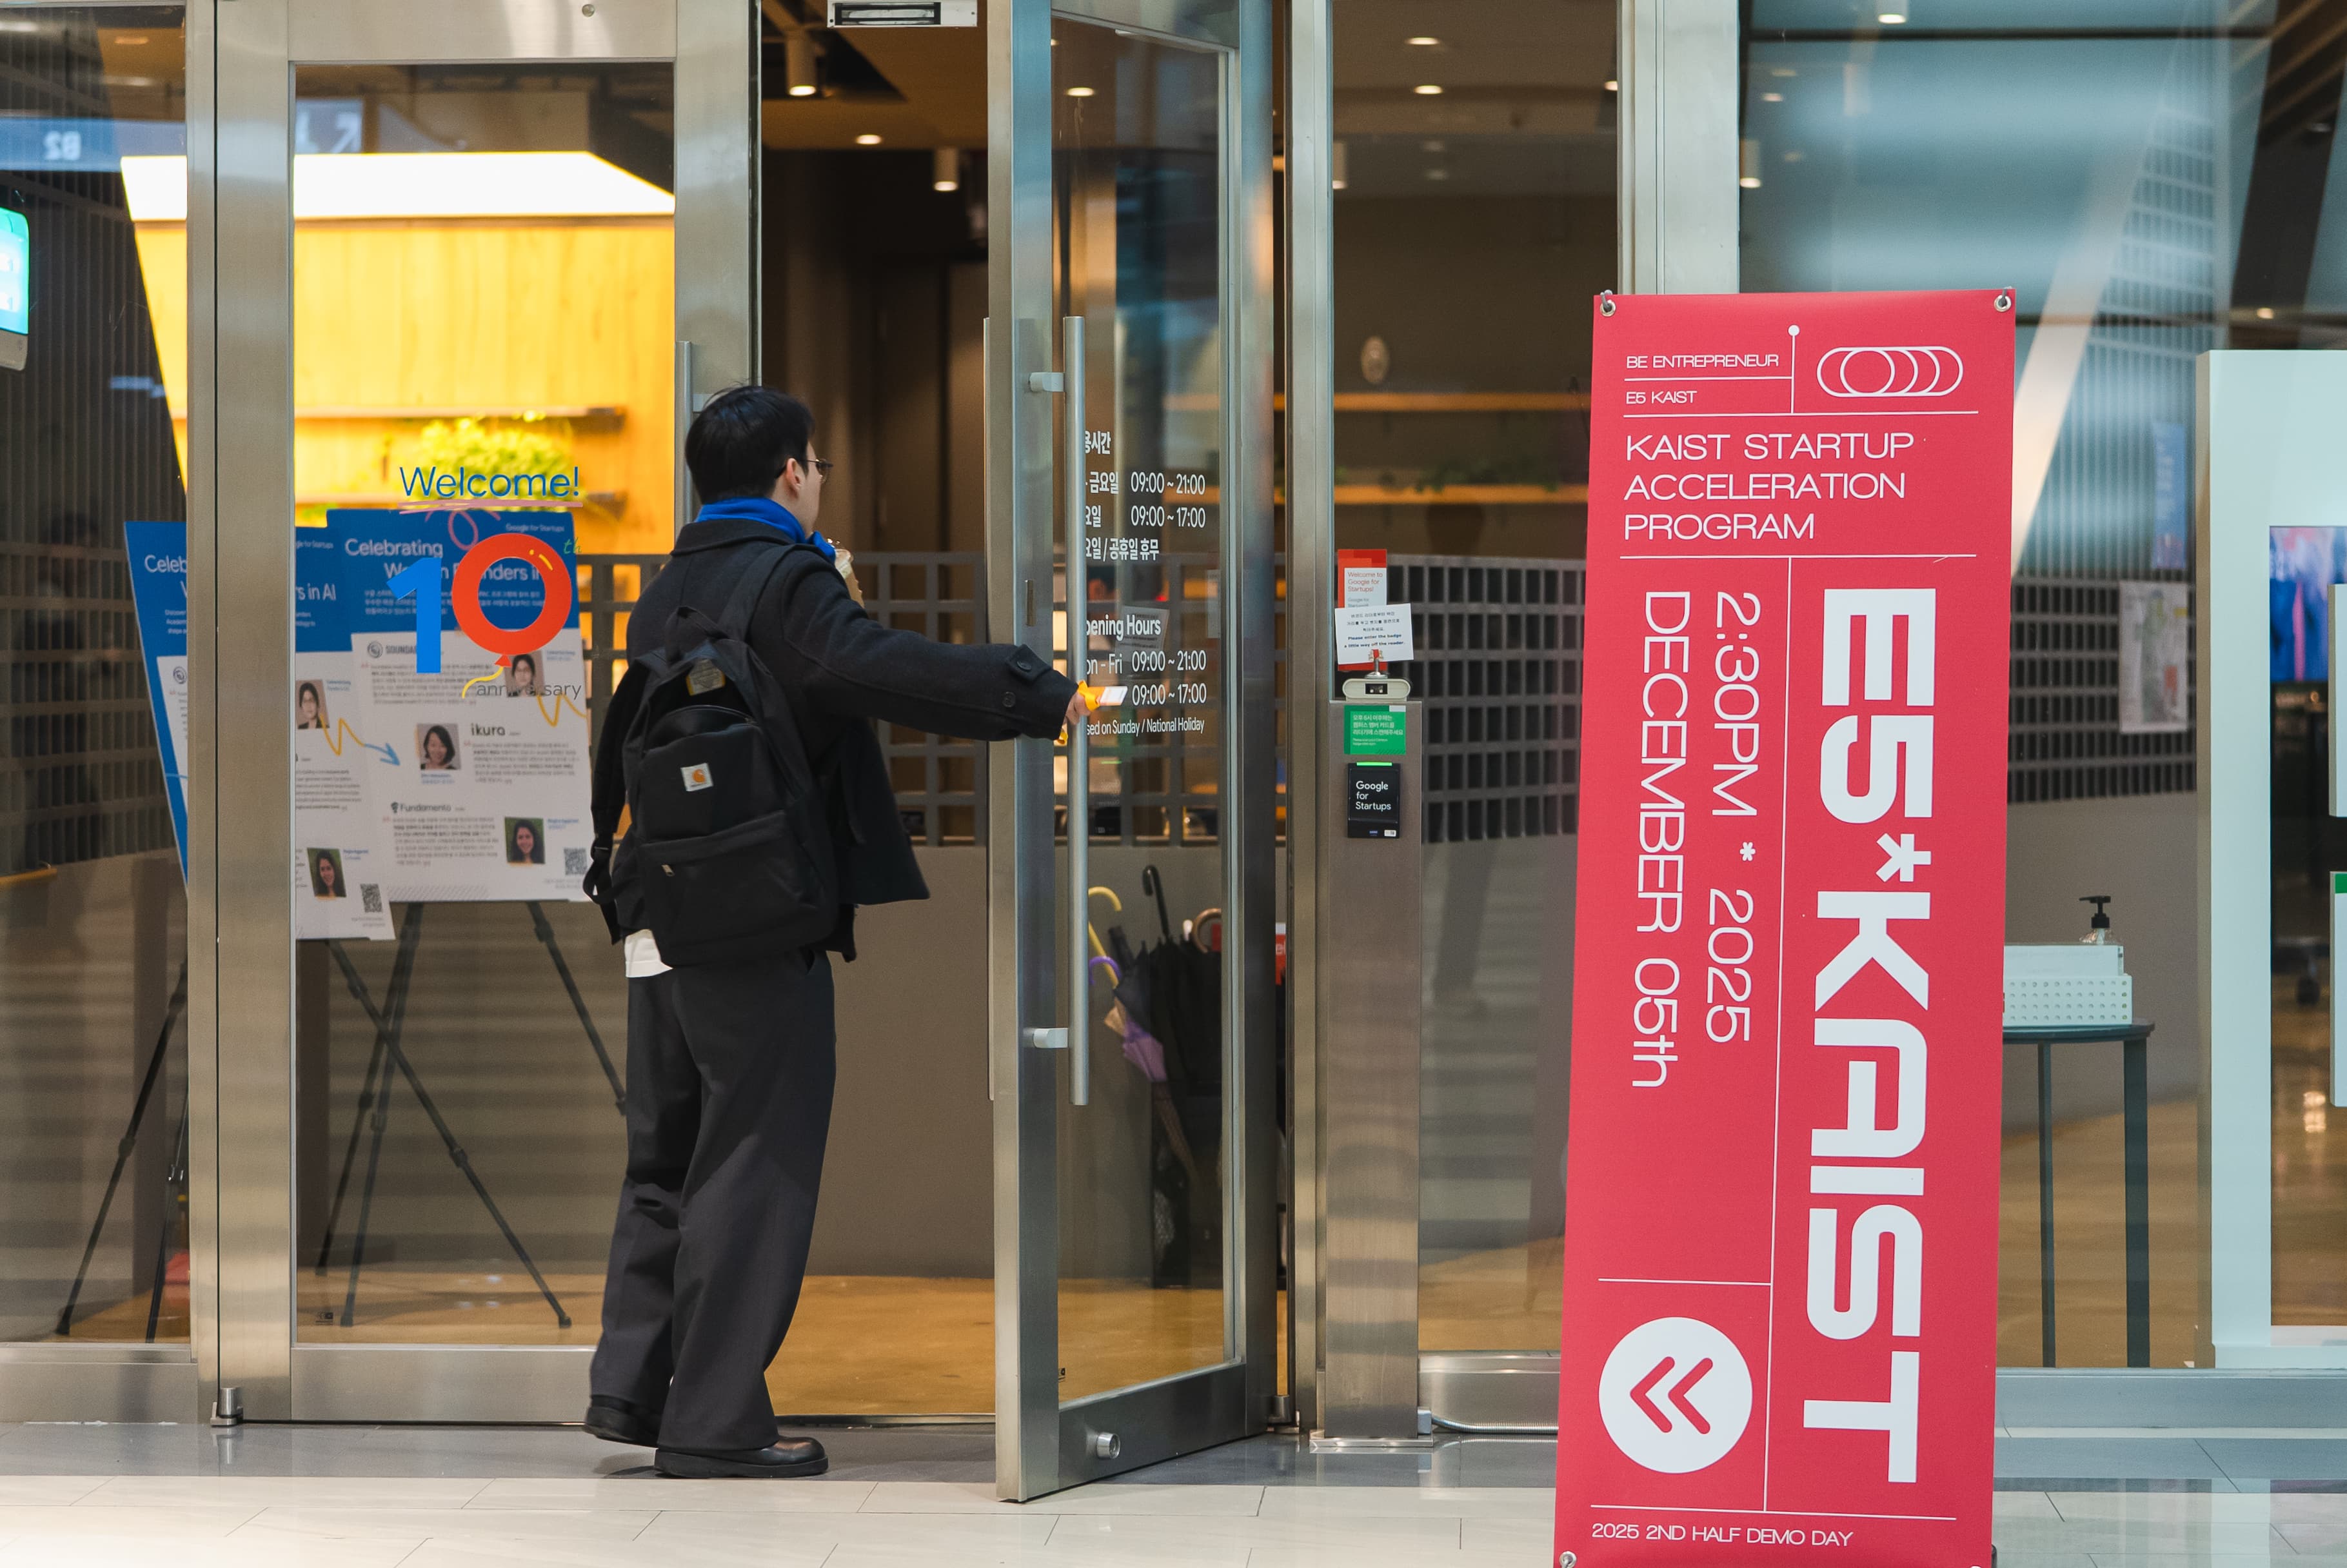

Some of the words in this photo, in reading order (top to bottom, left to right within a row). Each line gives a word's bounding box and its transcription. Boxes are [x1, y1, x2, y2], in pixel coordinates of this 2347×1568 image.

[1627, 355, 1648, 368] BE
[1652, 354, 1779, 368] ENTREPRENEUR
[1626, 391, 1646, 404] E5
[1651, 390, 1697, 404] KAIST
[1627, 434, 1731, 461] KAIST
[1744, 432, 1914, 460] STARTUP
[399, 466, 579, 497] Welcome!
[1089, 471, 1119, 494] 금요일
[1131, 471, 1165, 493] 09:00
[1176, 473, 1205, 495] 21:00
[1623, 473, 1906, 501] ACCELERATION
[1131, 505, 1165, 526] 09:00
[1176, 507, 1205, 528] 17:00
[1624, 513, 1815, 541] PROGRAM
[344, 537, 443, 558] Celebrating
[1109, 537, 1138, 561] 공휴일
[1140, 538, 1160, 561] 휴무
[144, 554, 186, 573] Celeb
[453, 562, 528, 581] Fnders
[1126, 614, 1161, 635] Hours
[1109, 653, 1122, 674] Fri
[1132, 650, 1165, 672] 09:00
[1177, 650, 1206, 671] 21:00
[476, 684, 582, 700] annesary
[1132, 684, 1166, 706] 09:00
[1177, 682, 1207, 704] 17:00
[1712, 591, 1761, 817] 2:30PM
[1086, 722, 1100, 735] sed
[1102, 724, 1112, 735] on
[1112, 719, 1140, 737] Sunday
[1147, 717, 1176, 733] National
[1178, 717, 1205, 734] Holiday
[1636, 591, 1690, 933] DECEMBER
[1356, 780, 1389, 792] Google
[1356, 791, 1369, 800] for
[1356, 801, 1391, 812] Startups
[1705, 888, 1754, 1043] 2025
[1632, 958, 1680, 1087] 05th
[1591, 1522, 1639, 1540] 2025
[1645, 1524, 1686, 1541] 2ND
[1692, 1525, 1741, 1542] HALF
[1746, 1527, 1806, 1545] DEMO
[1812, 1529, 1854, 1547] DAY
